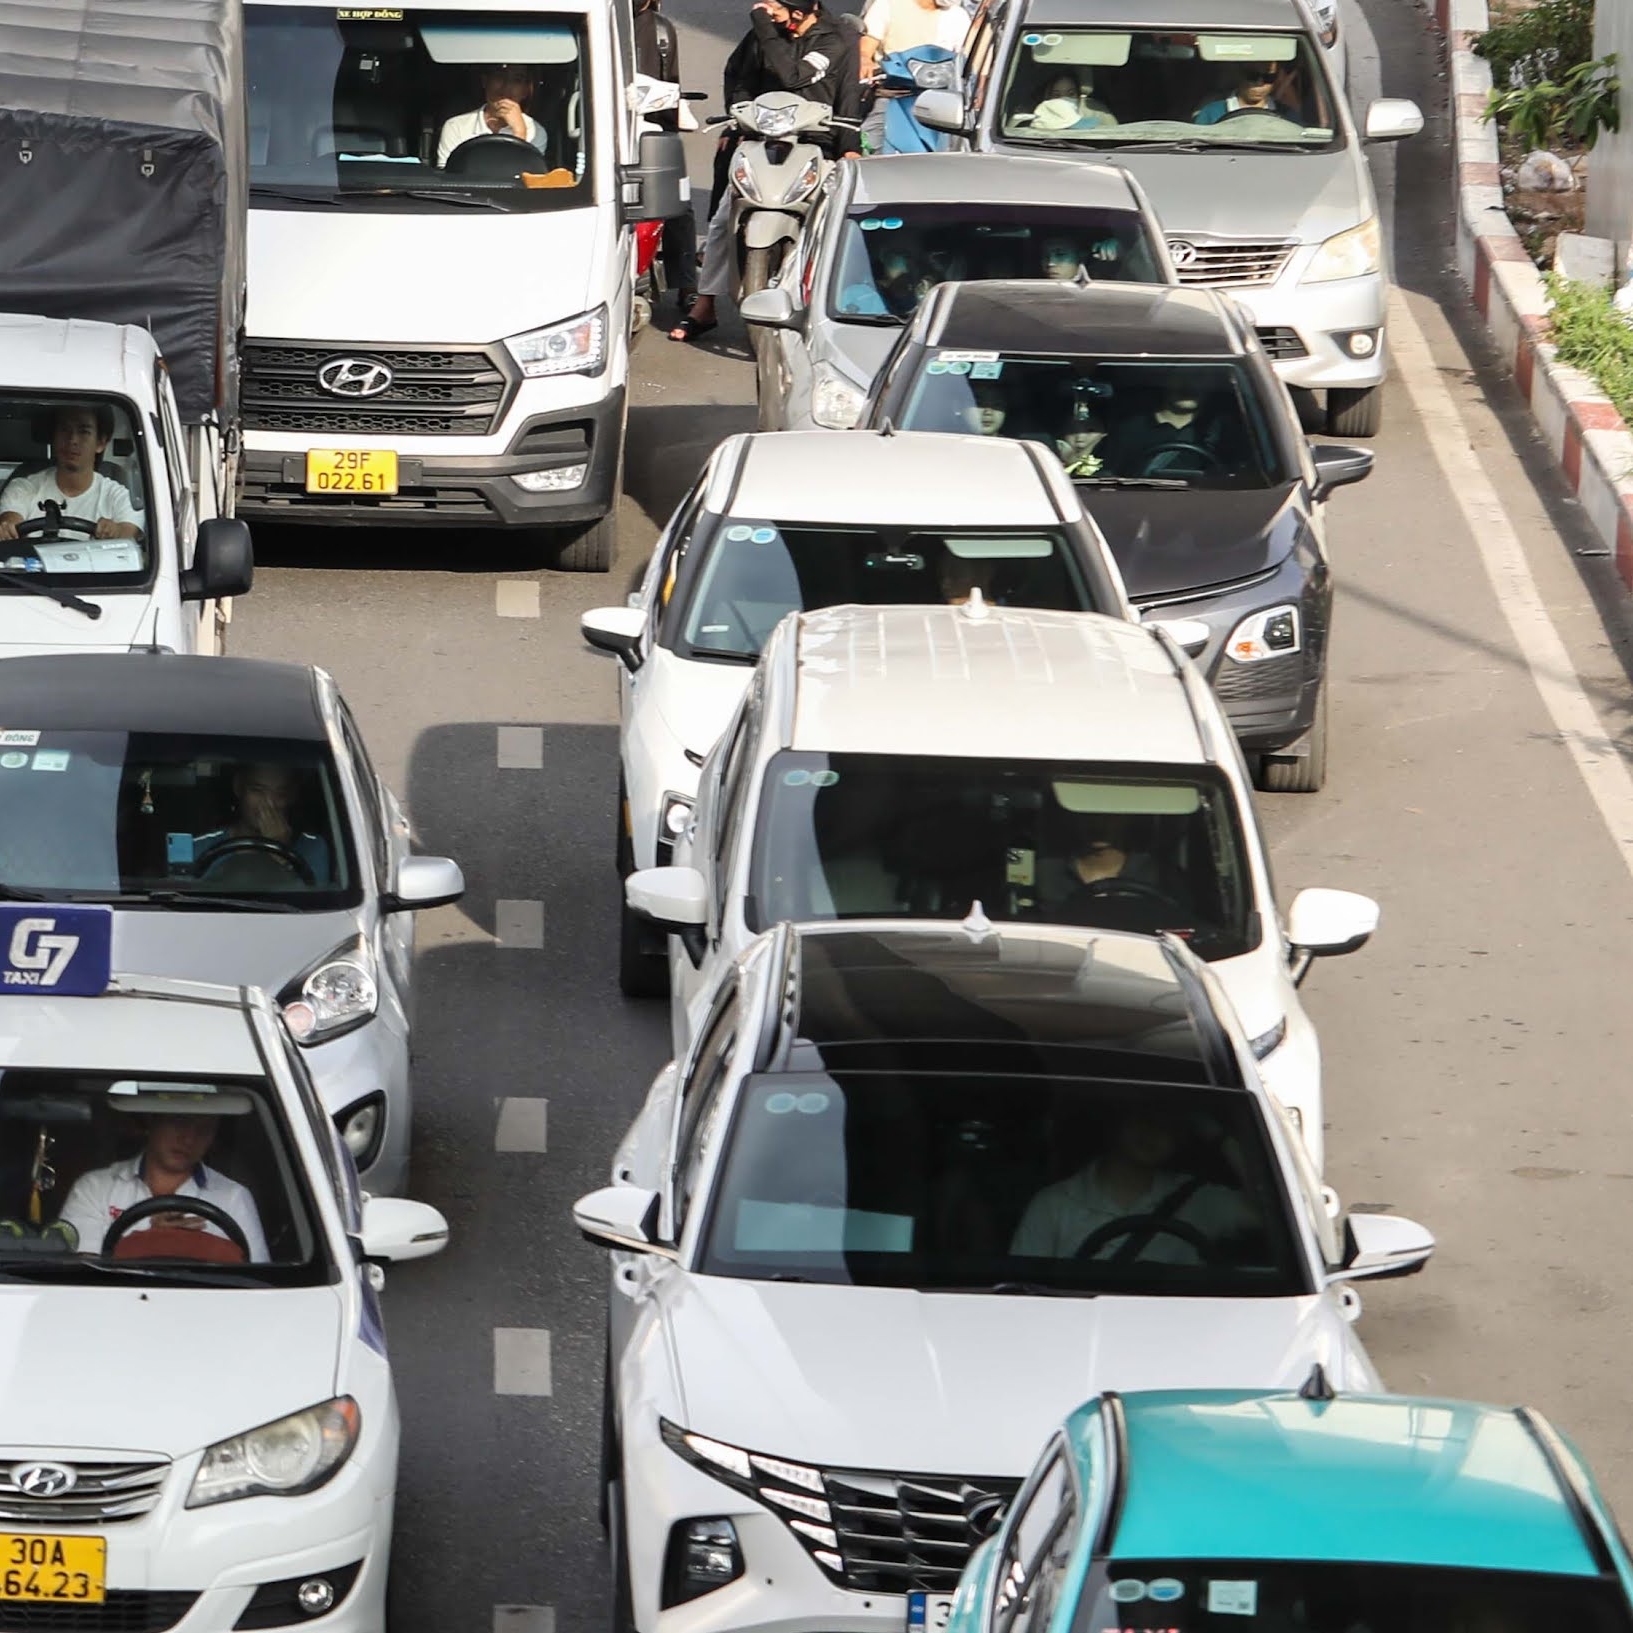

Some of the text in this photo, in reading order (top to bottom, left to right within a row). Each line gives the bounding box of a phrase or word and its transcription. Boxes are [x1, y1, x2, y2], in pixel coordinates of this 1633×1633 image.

[334, 451, 371, 470] 29F
[317, 471, 386, 491] 022.61
[8, 918, 80, 985] G7
[2, 970, 39, 985] TAXI
[10, 1537, 66, 1567] 30A
